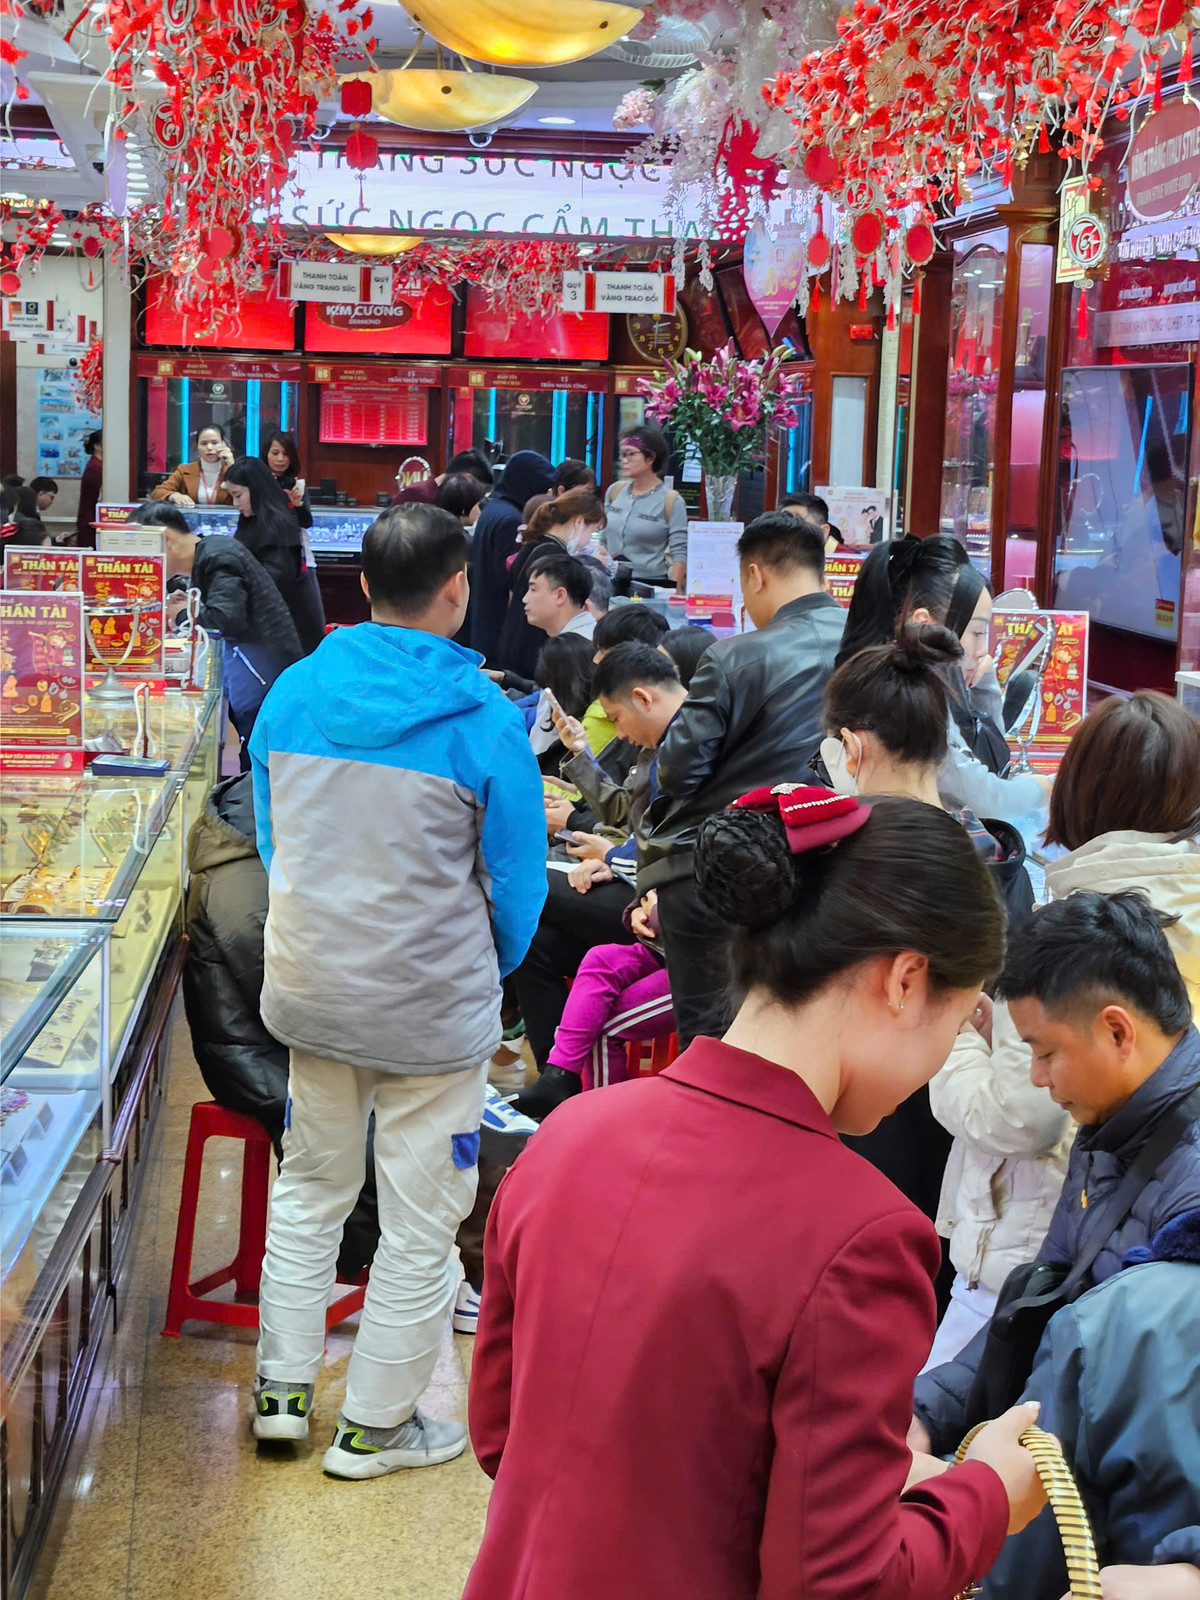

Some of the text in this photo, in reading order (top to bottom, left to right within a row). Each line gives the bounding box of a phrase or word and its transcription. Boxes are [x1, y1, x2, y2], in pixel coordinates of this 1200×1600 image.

[302, 272, 327, 280] THANH
[294, 281, 315, 290] VÀNG
[316, 284, 340, 292] TRANG
[378, 285, 384, 294] 1
[606, 283, 632, 291] THANH
[570, 290, 577, 300] 3
[600, 293, 622, 302] VÀNG
[326, 305, 352, 316] KIM
[133, 561, 154, 574] TÀI
[824, 561, 861, 573] HẦN TÀ
[0, 602, 67, 618] HẦN TÀI
